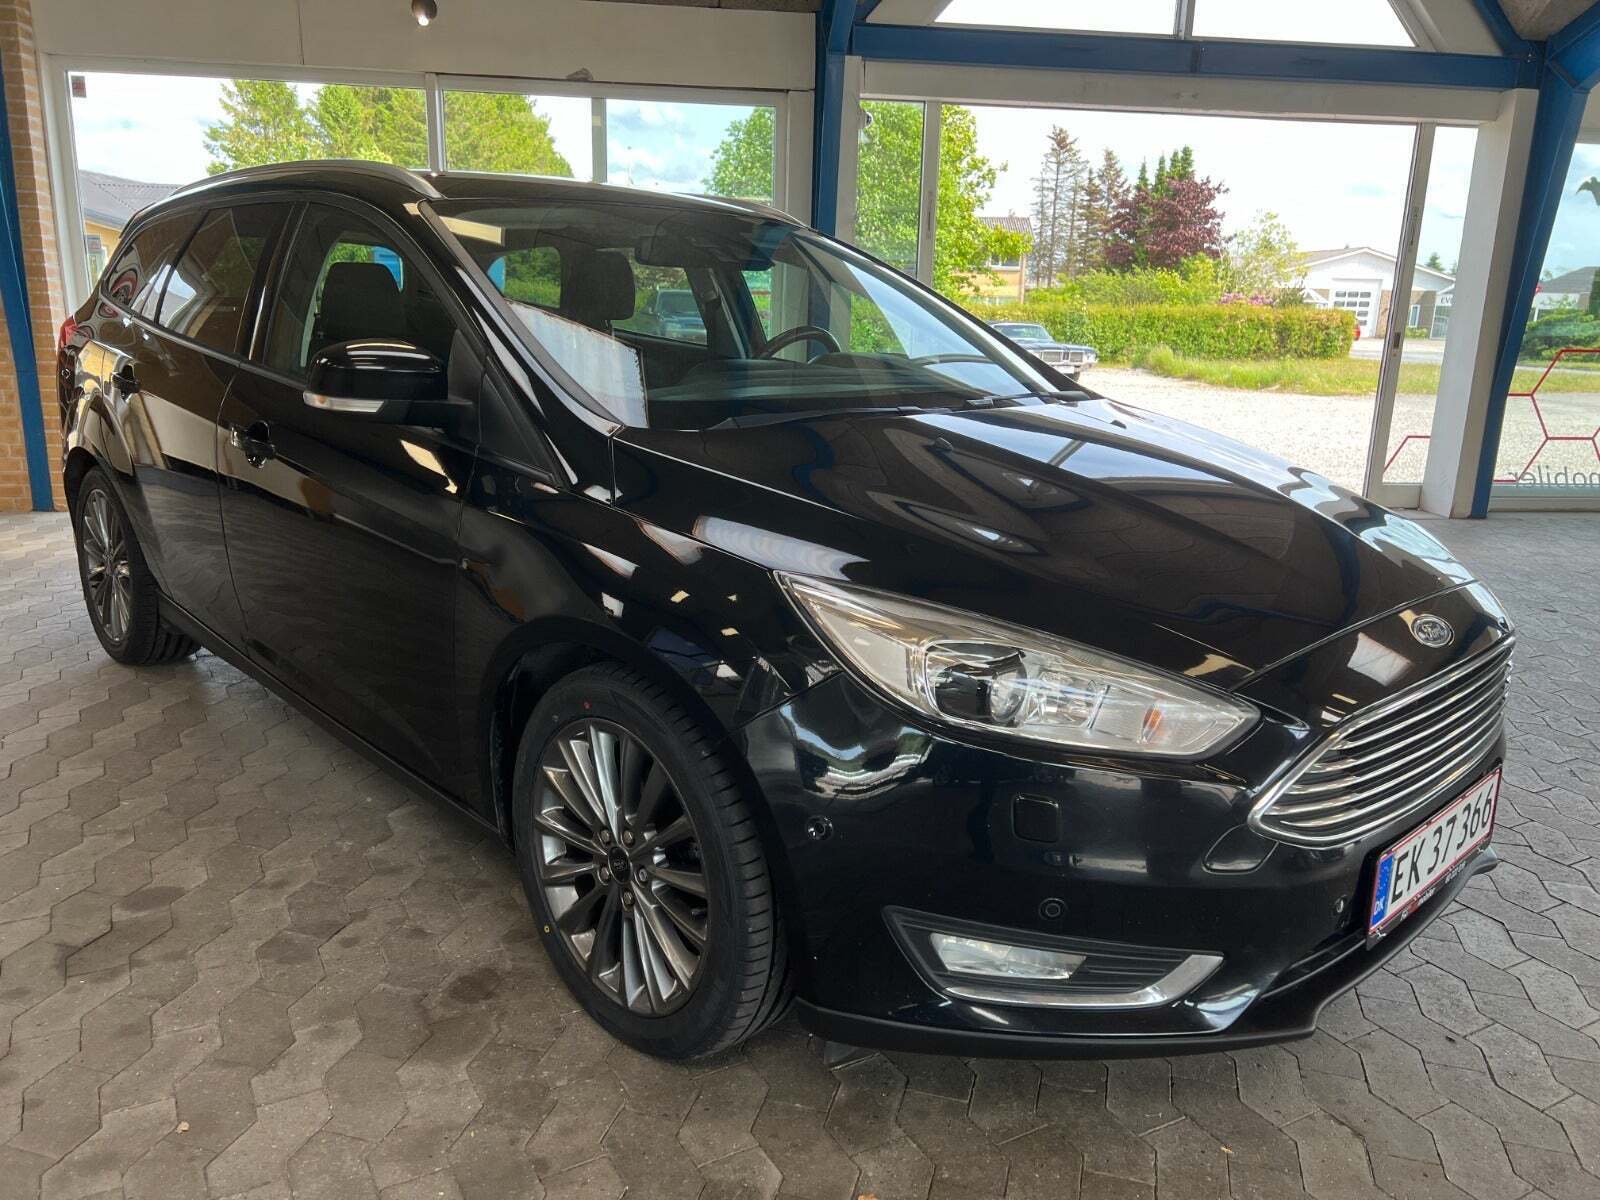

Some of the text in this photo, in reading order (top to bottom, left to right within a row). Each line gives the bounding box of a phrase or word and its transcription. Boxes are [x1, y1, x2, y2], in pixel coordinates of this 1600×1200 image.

[1391, 783, 1494, 905] EK 37 366
